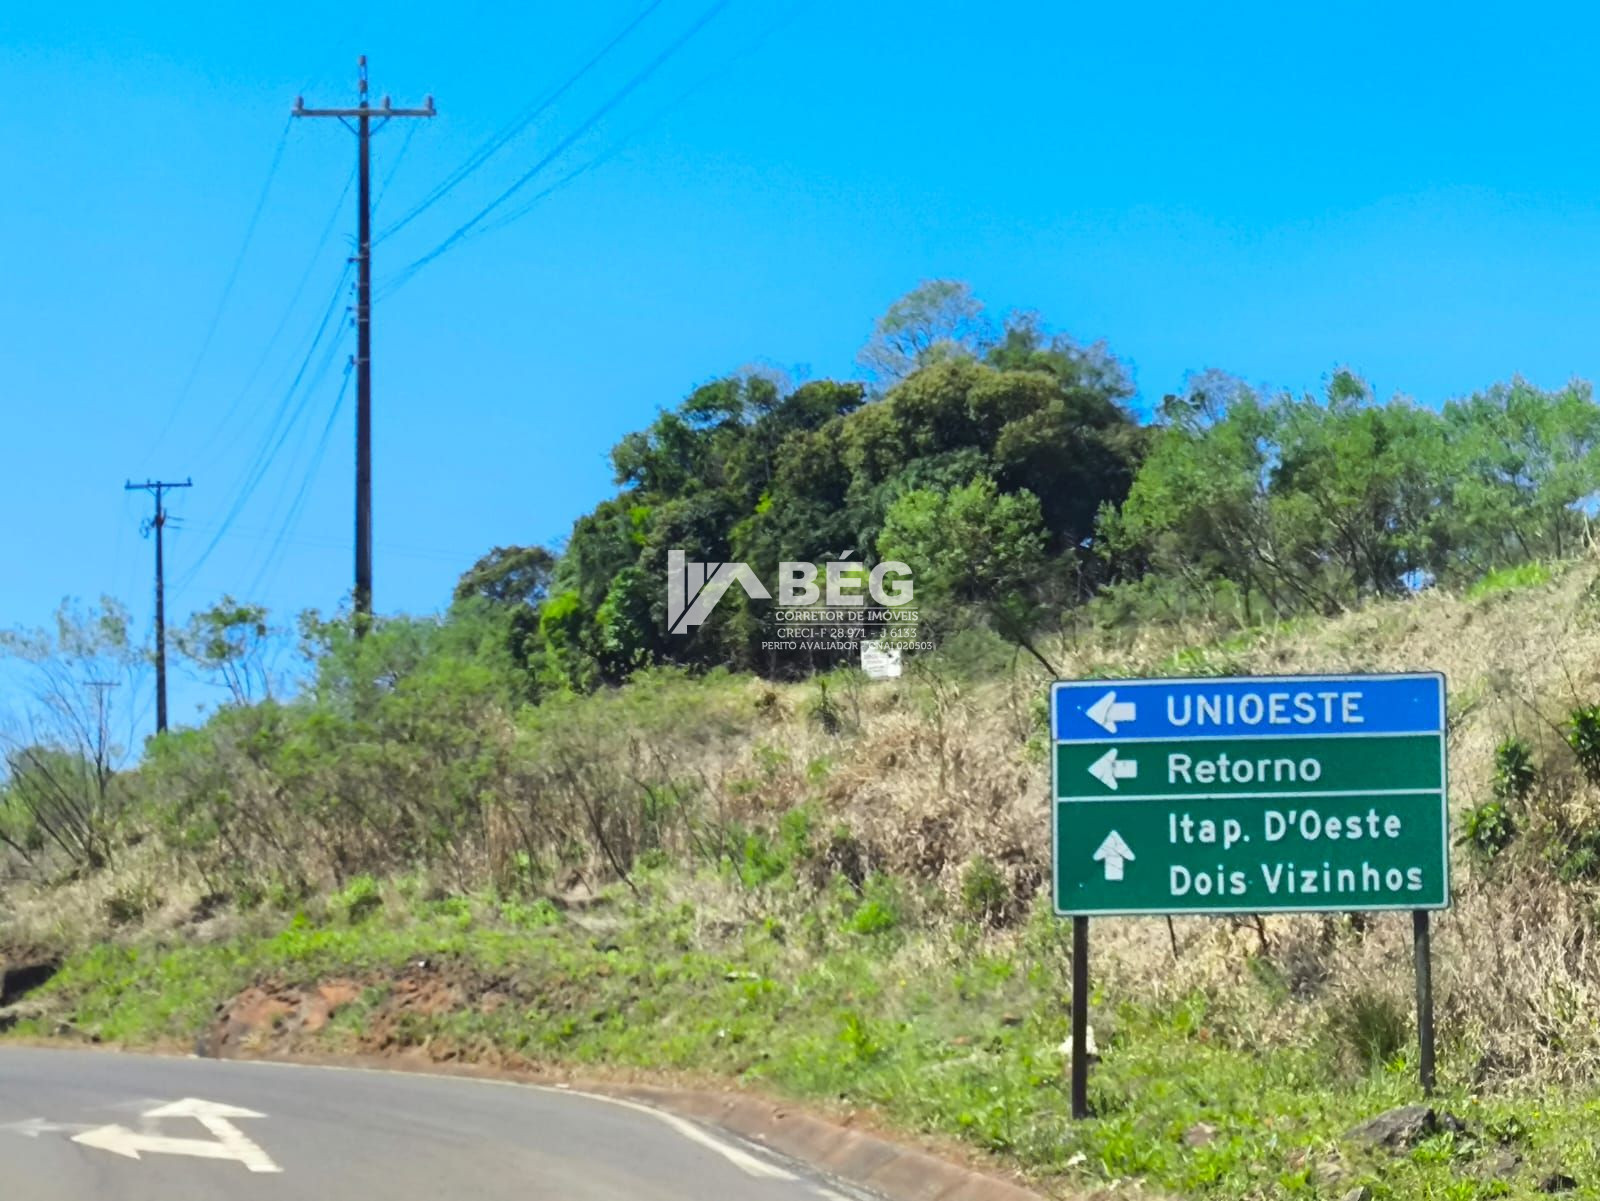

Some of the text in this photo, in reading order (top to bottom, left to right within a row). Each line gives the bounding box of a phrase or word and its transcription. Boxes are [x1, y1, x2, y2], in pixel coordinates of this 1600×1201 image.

[1166, 691, 1365, 727] UNIOESTE
[1168, 753, 1322, 784] Retorno
[1169, 808, 1402, 850] Itap. D'Oeste
[1170, 861, 1424, 896] Dois Vizinhos
